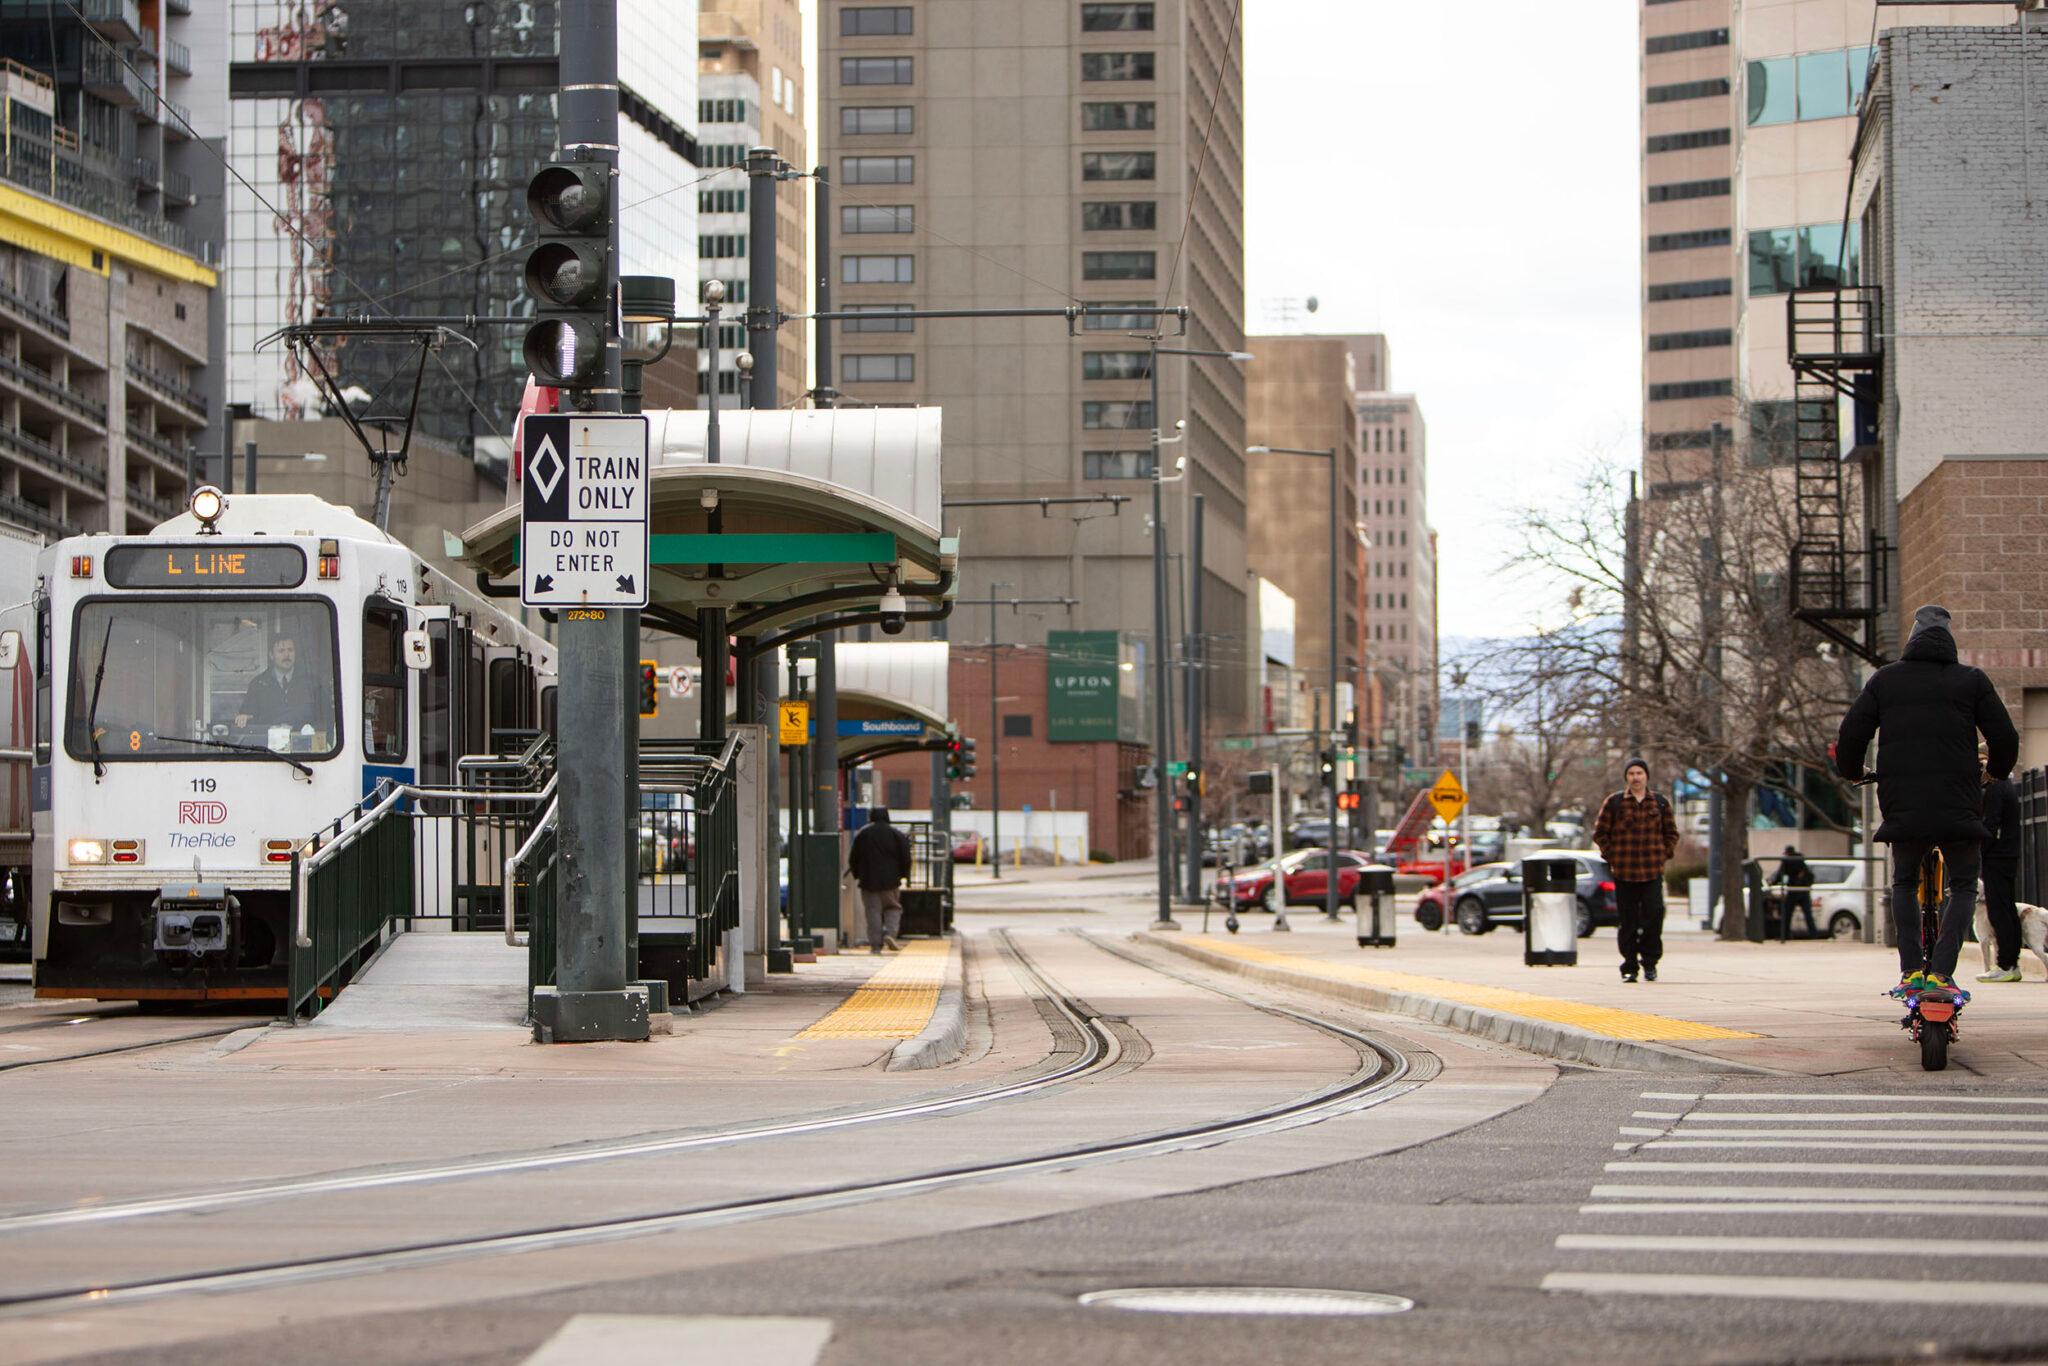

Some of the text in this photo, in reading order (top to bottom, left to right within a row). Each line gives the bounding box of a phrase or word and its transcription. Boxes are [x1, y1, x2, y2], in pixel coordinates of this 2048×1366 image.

[576, 457, 639, 479] TRAIN
[579, 486, 634, 509] ONLY
[551, 531, 619, 548] DO NOT
[168, 554, 246, 574] L LINE
[556, 555, 613, 571] ENTER
[396, 579, 407, 593] 119
[862, 722, 920, 731] Southbound
[130, 731, 141, 751] 8
[191, 778, 217, 792] 119
[179, 801, 227, 824] RTD
[168, 832, 236, 848] TheRide
